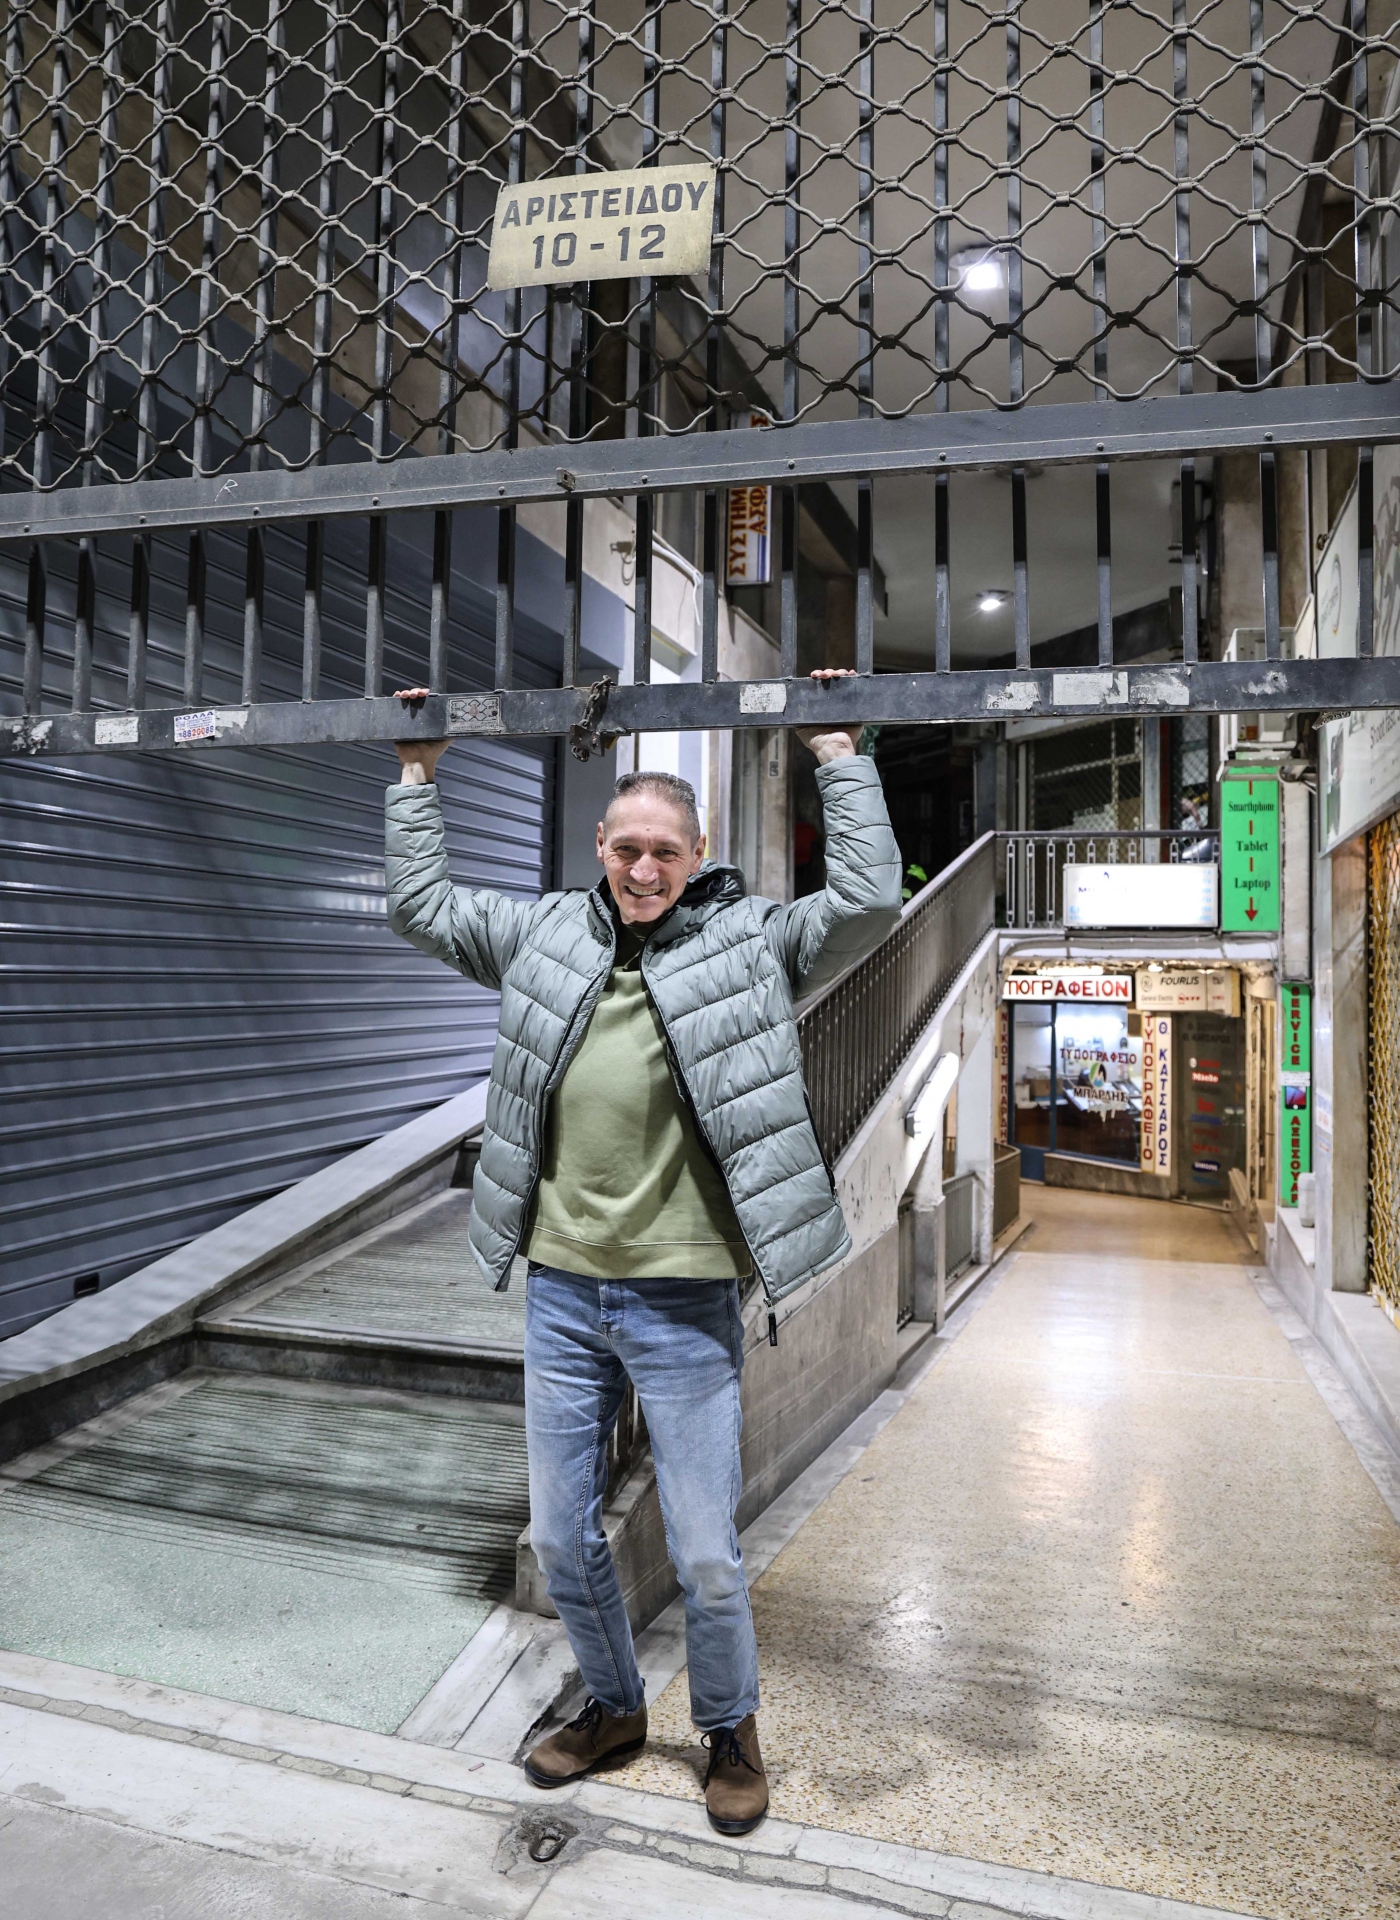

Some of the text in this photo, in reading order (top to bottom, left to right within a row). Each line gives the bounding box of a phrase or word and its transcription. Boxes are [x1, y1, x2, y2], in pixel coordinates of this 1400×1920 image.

[500, 180, 709, 230] ΑΡΙΣΤΕΙΔΟΥ
[729, 486, 748, 578] ΣΥΣΤΗΜ
[1228, 801, 1275, 814] Smarthphone
[1236, 840, 1268, 852] Tablet
[1234, 877, 1271, 891] Laptop
[1005, 979, 1129, 998] ΠΟΓΡΑΦΕΙΟΝ
[1160, 976, 1199, 986] FOURLIS
[1290, 986, 1301, 1066] SERVICE
[1000, 1012, 1008, 1066] ΝΙΚΟΣ
[1059, 1047, 1137, 1065] ΤΥΠΟΓΡΑΦΕΙΟ
[1073, 1086, 1129, 1104] ΜΠΑΡΔΗΣ
[1158, 1048, 1168, 1166] ΚΑΤΣΑΡΟΣ
